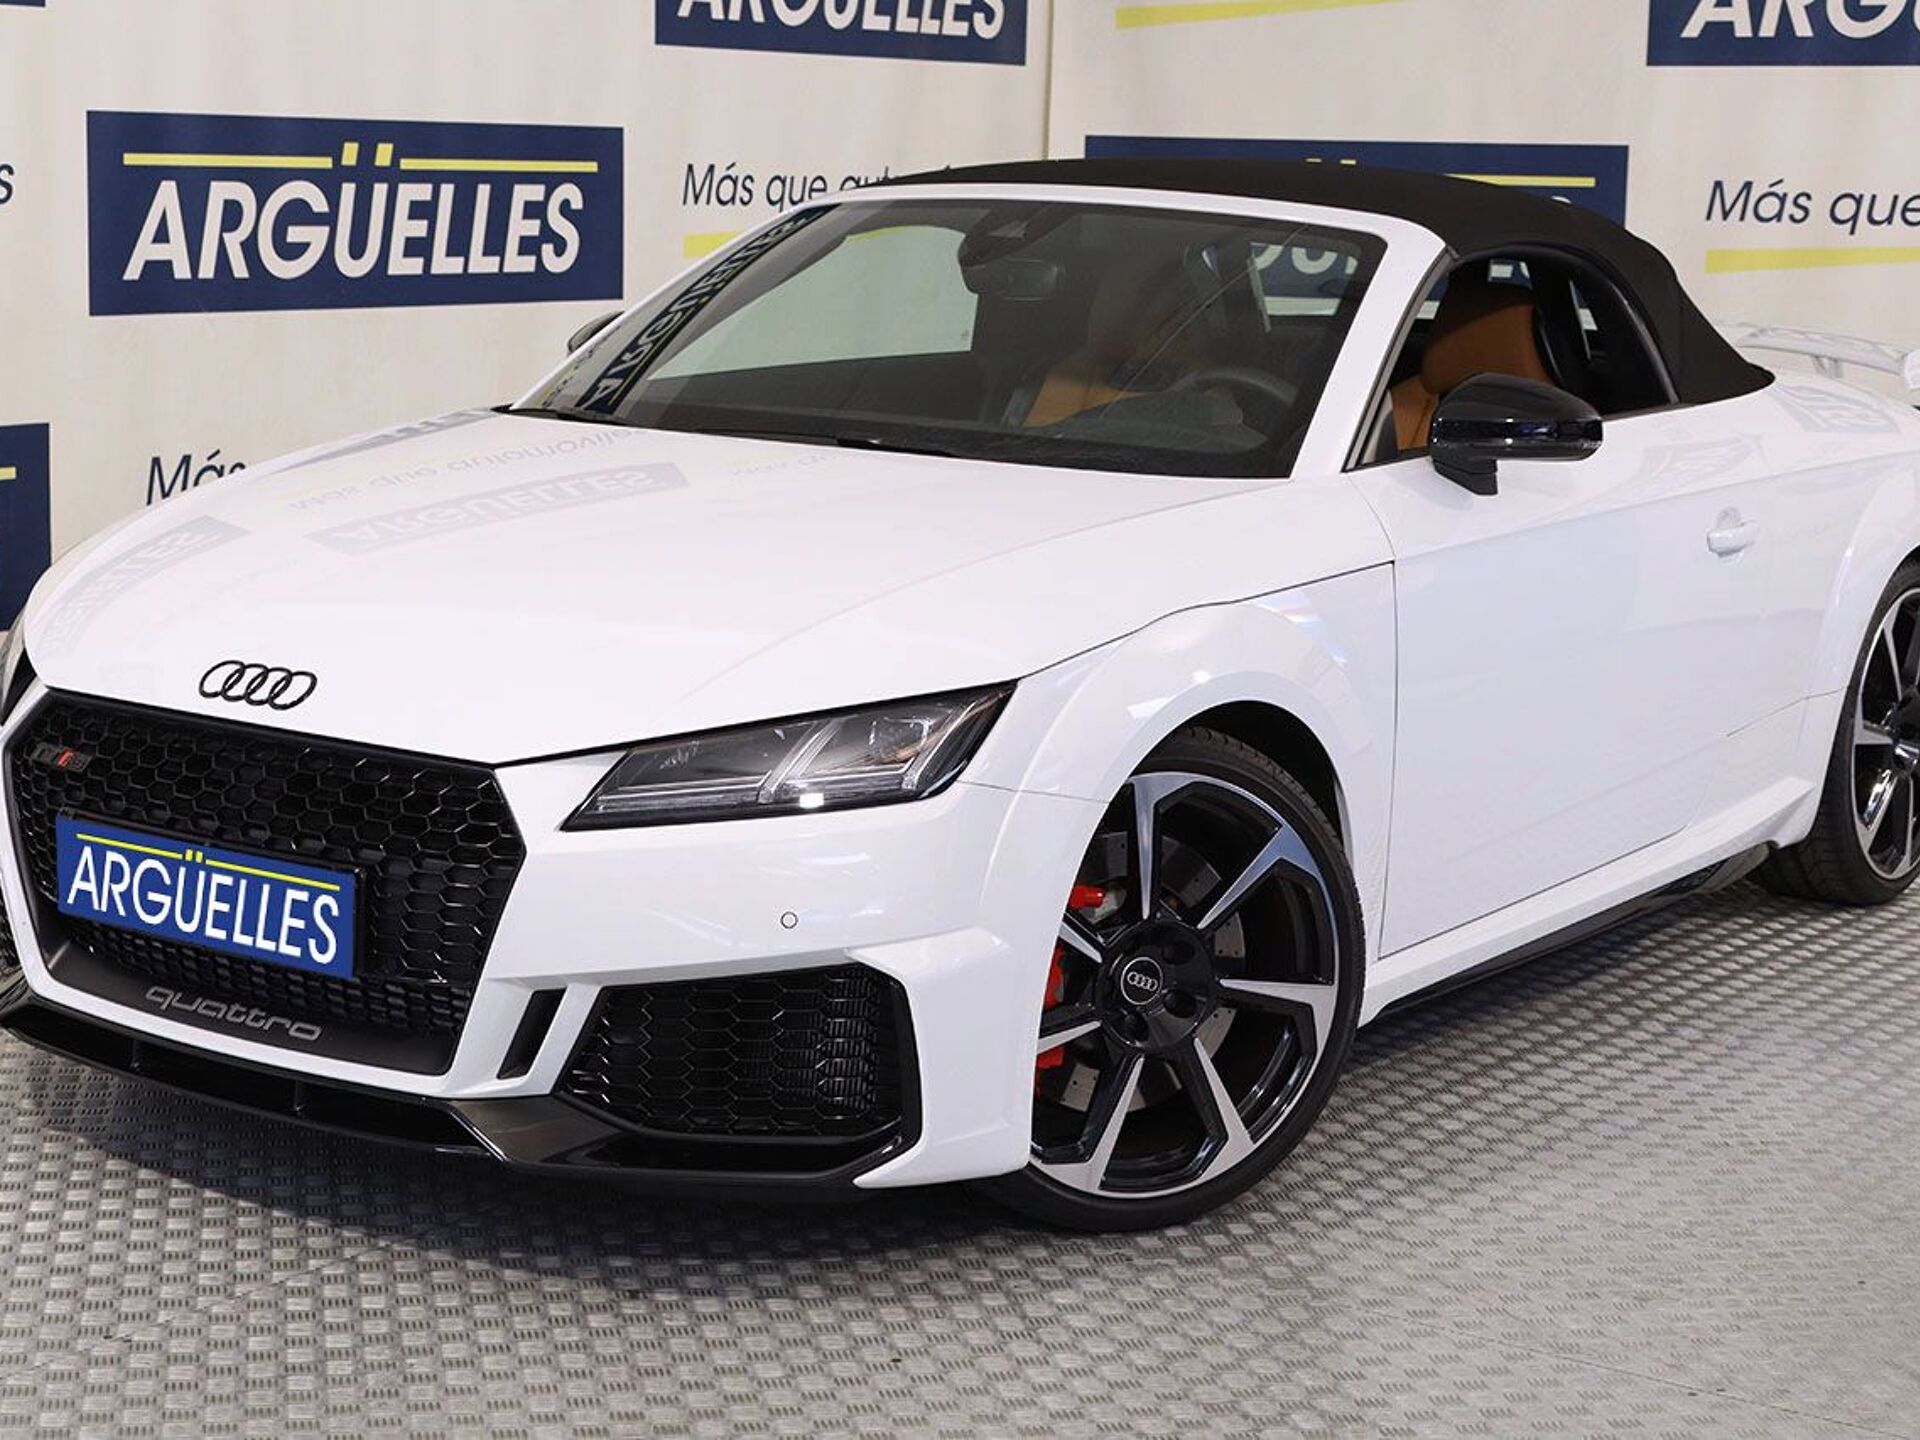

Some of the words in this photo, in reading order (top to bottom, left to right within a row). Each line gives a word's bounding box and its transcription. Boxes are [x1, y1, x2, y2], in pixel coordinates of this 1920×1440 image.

[122, 142, 583, 281] ARGÜELLES
[682, 162, 755, 206] Más
[766, 175, 828, 212] que
[1705, 178, 1812, 224] Más
[1829, 192, 1920, 236] que
[146, 448, 246, 506] Má
[66, 846, 340, 965] ARGÜELLES
[145, 985, 322, 1041] quattro
